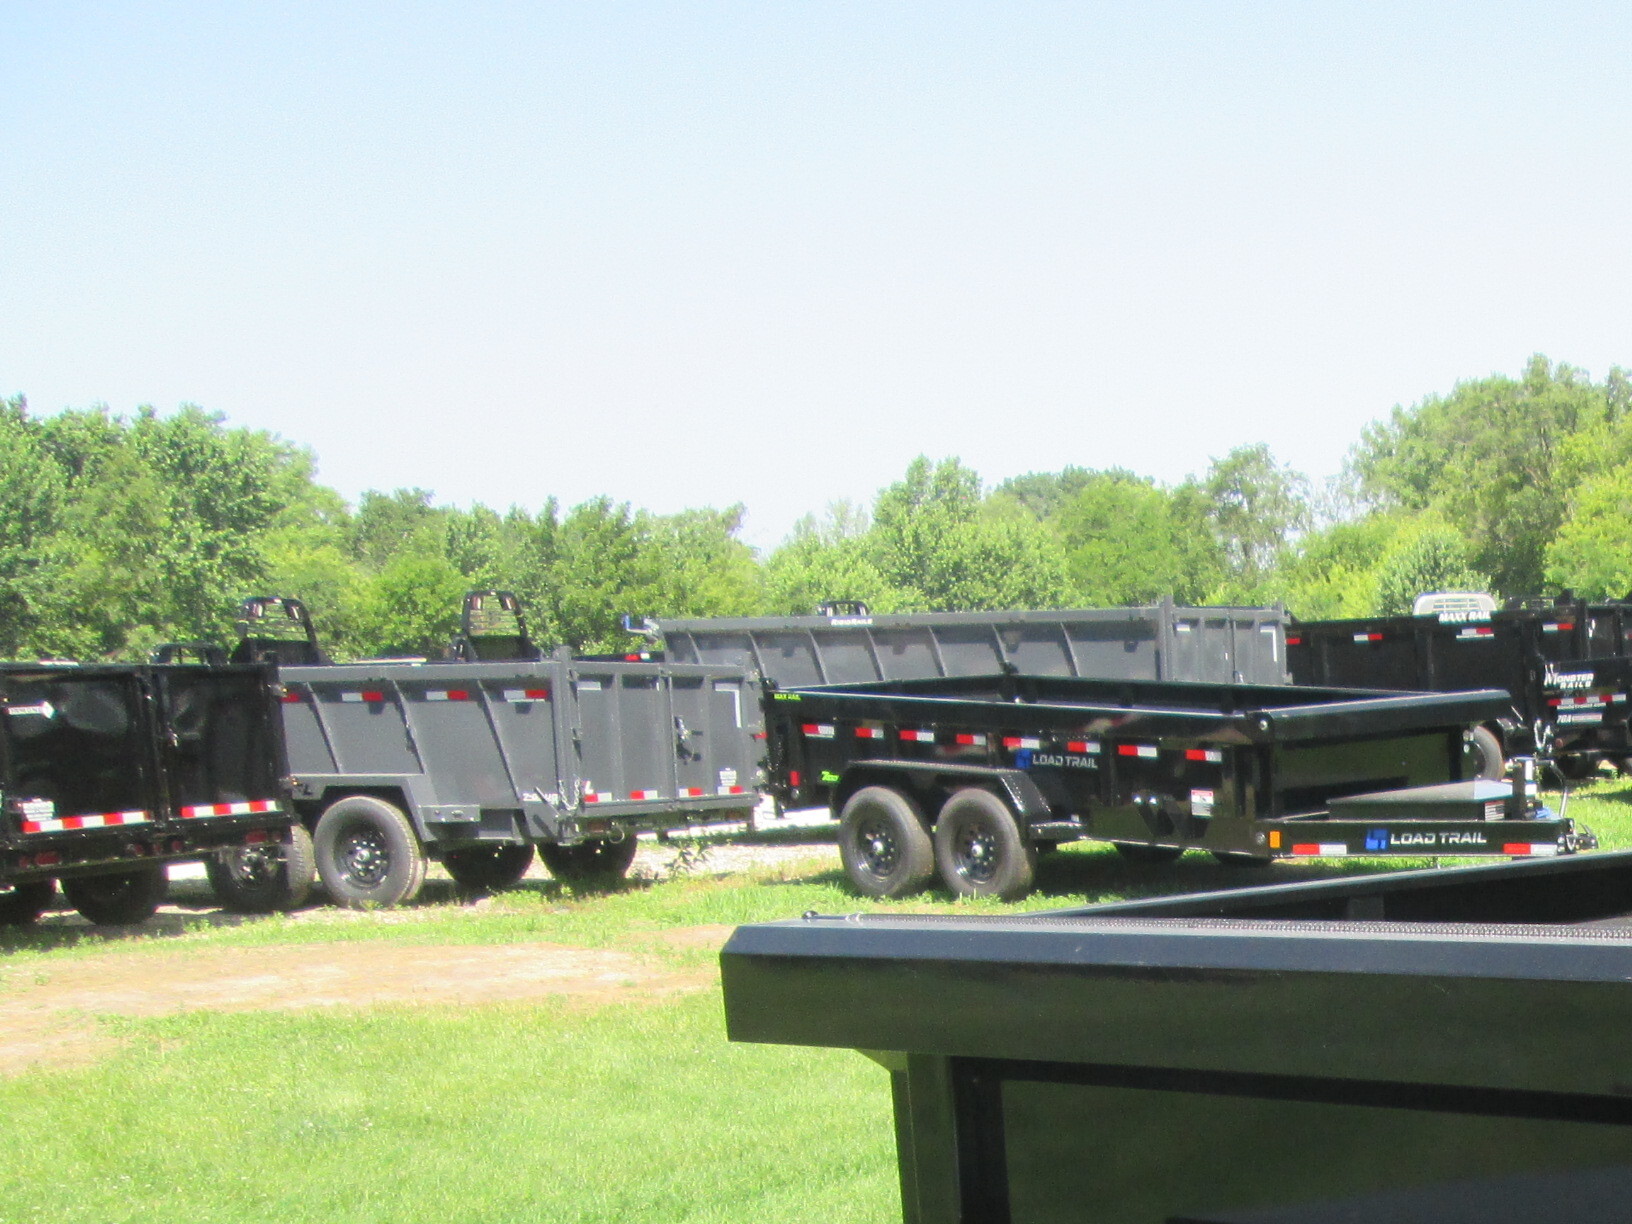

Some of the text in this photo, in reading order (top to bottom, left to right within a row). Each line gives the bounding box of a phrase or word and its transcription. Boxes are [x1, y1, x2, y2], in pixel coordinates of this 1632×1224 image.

[1468, 611, 1491, 623] RAIL
[1544, 664, 1594, 687] MONSTER
[1032, 753, 1098, 768] LOAD TRAIL
[1390, 832, 1487, 845] LOAD TRAIL
